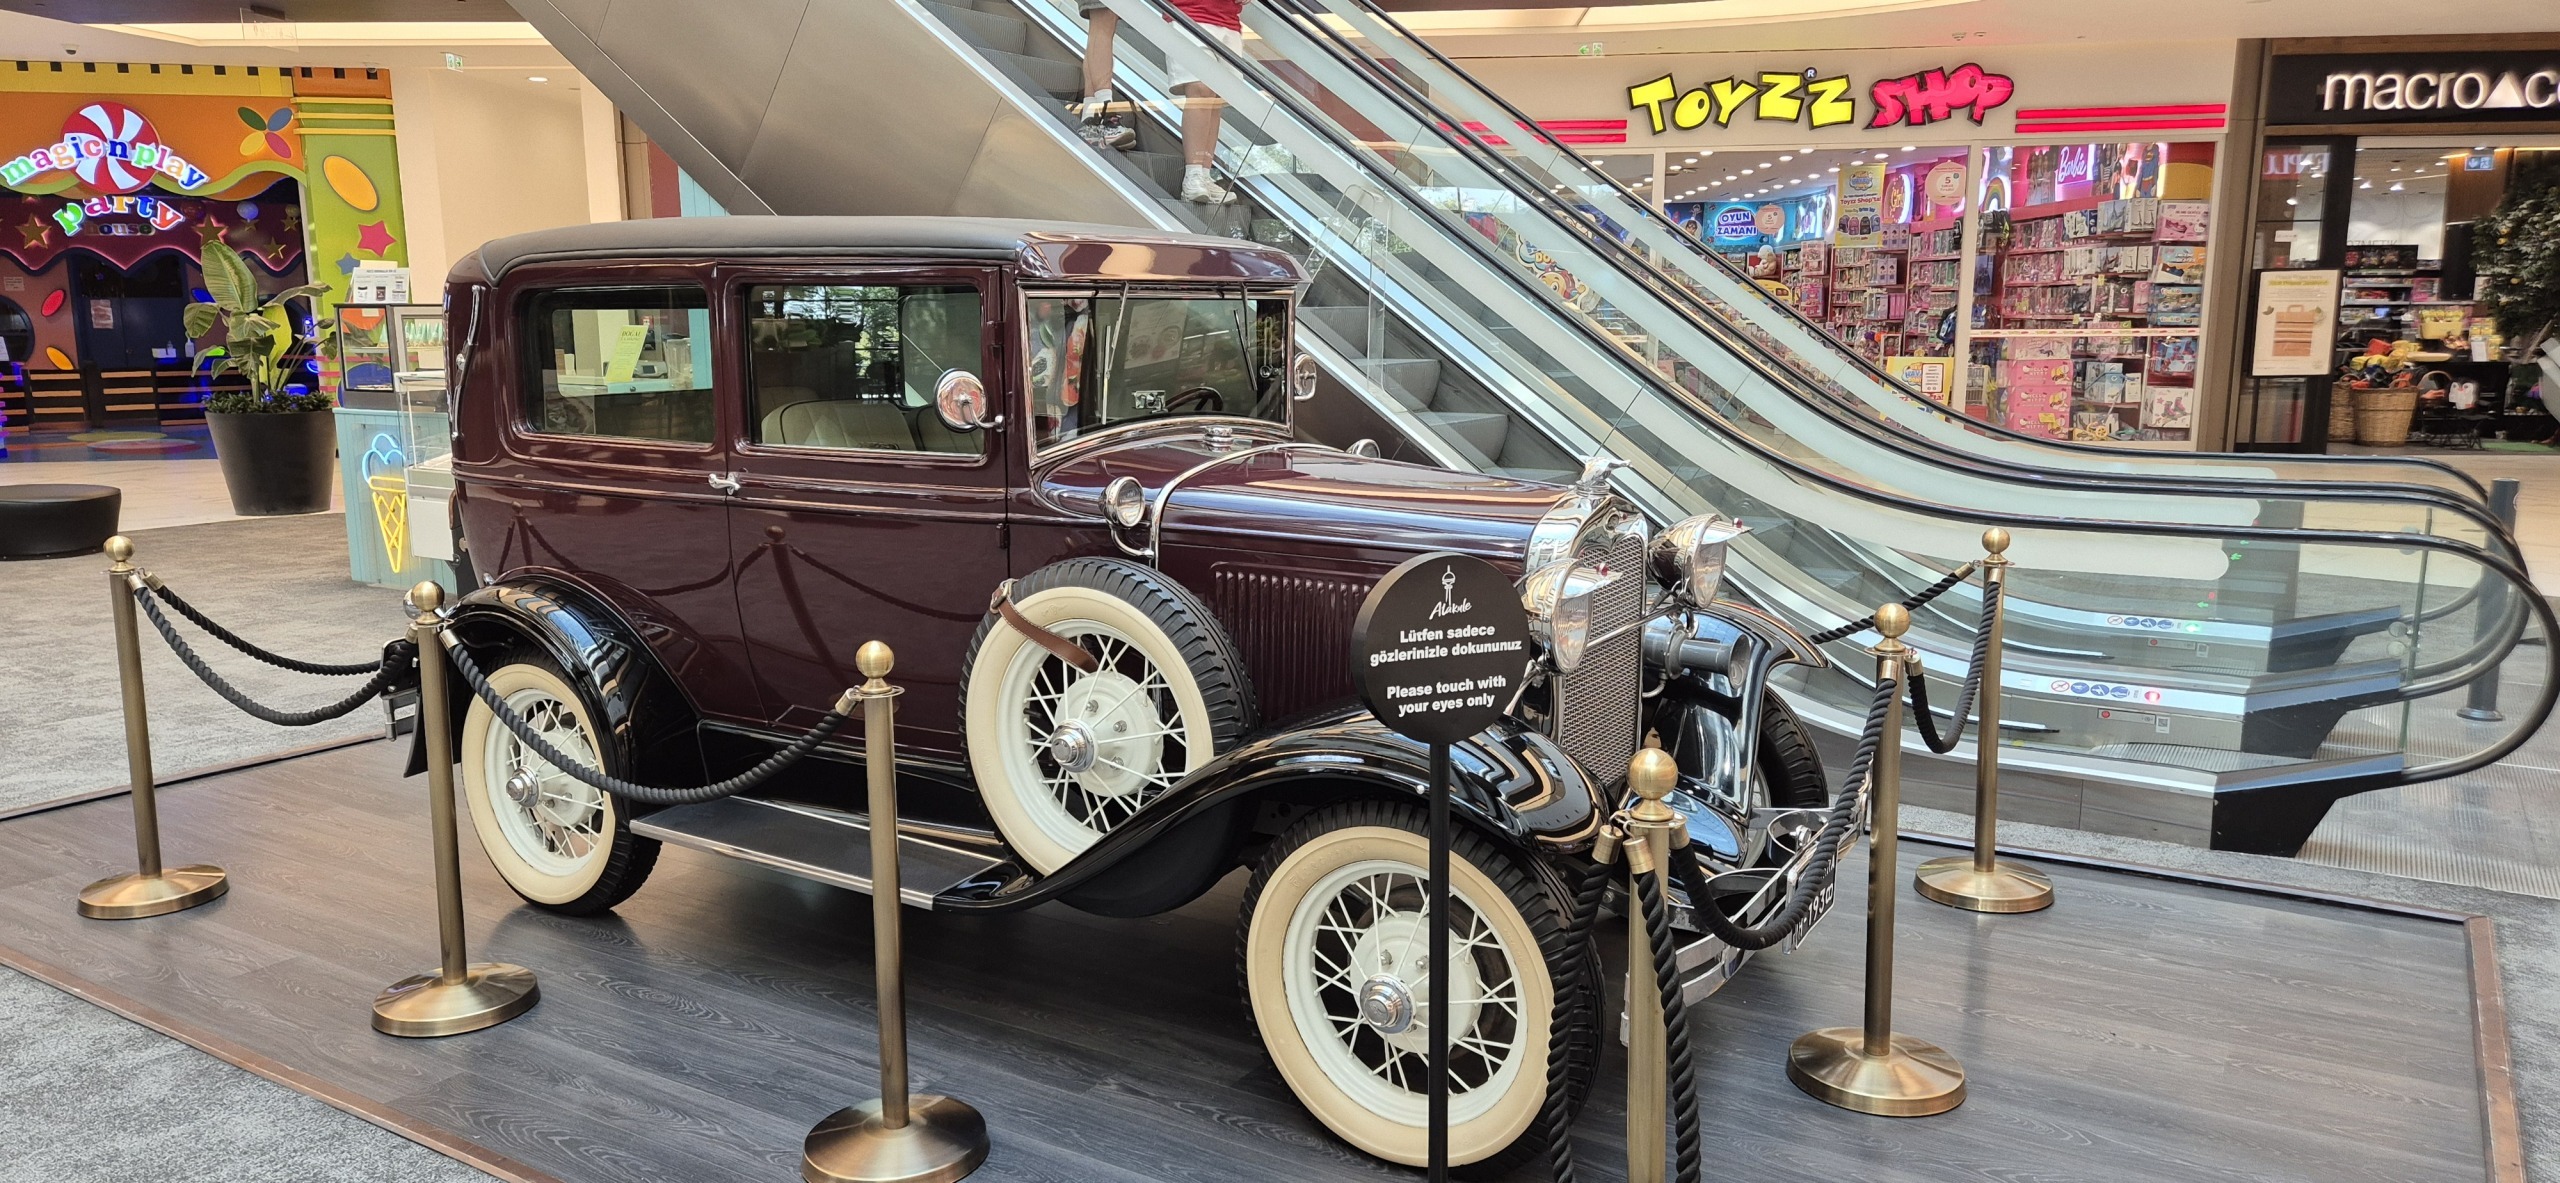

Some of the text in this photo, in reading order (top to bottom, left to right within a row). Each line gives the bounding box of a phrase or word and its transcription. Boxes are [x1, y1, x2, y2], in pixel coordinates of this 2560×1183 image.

[1863, 62, 2015, 131] SHOP
[133, 142, 210, 190] play
[2058, 146, 2088, 183] Barbie
[52, 196, 185, 237] party
[1720, 211, 1750, 223] OYUN
[85, 222, 156, 237] house
[1717, 226, 1758, 236] ZAMANI
[1400, 624, 1495, 643] Lütfen sadece
[1370, 640, 1522, 667] gözlerinizle dokununuz
[1387, 676, 1506, 699] Please touch with
[1399, 693, 1495, 718] your eyes only
